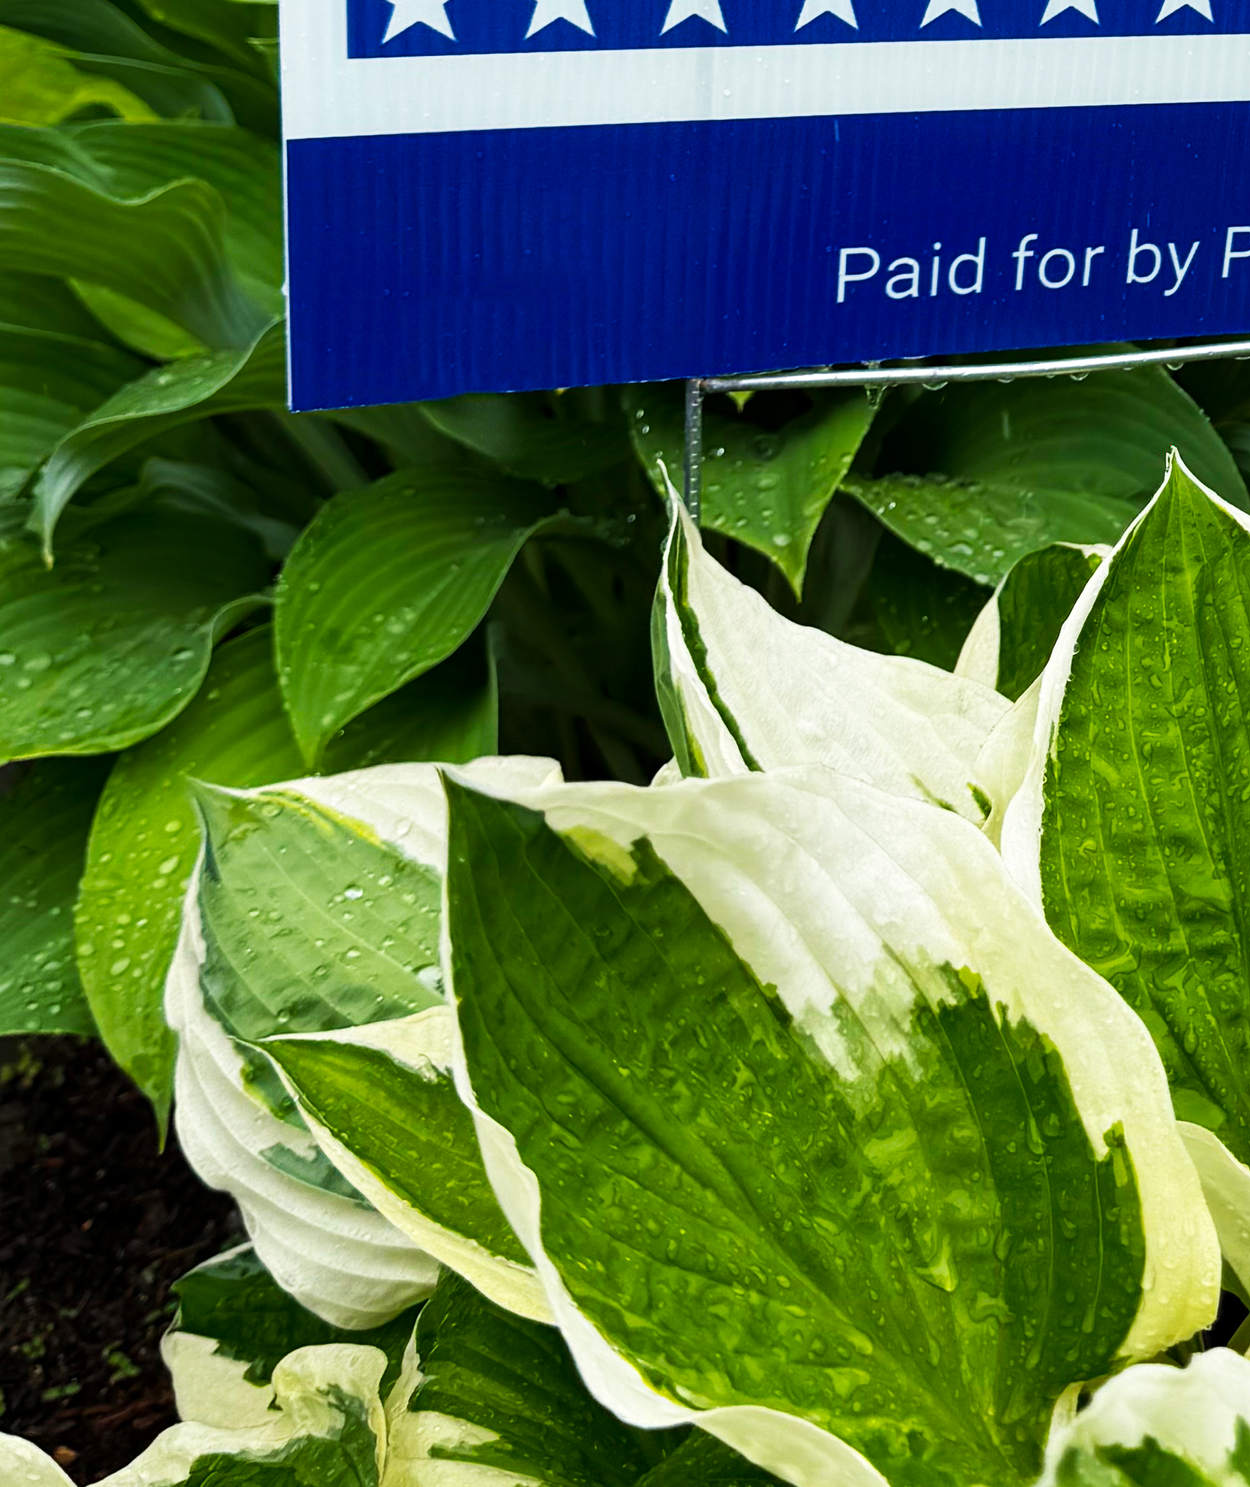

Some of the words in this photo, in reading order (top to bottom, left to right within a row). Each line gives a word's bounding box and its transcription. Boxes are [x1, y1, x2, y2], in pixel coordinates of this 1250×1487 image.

[837, 237, 986, 303] Paid
[1012, 233, 1105, 291] for
[1126, 228, 1200, 297] by
